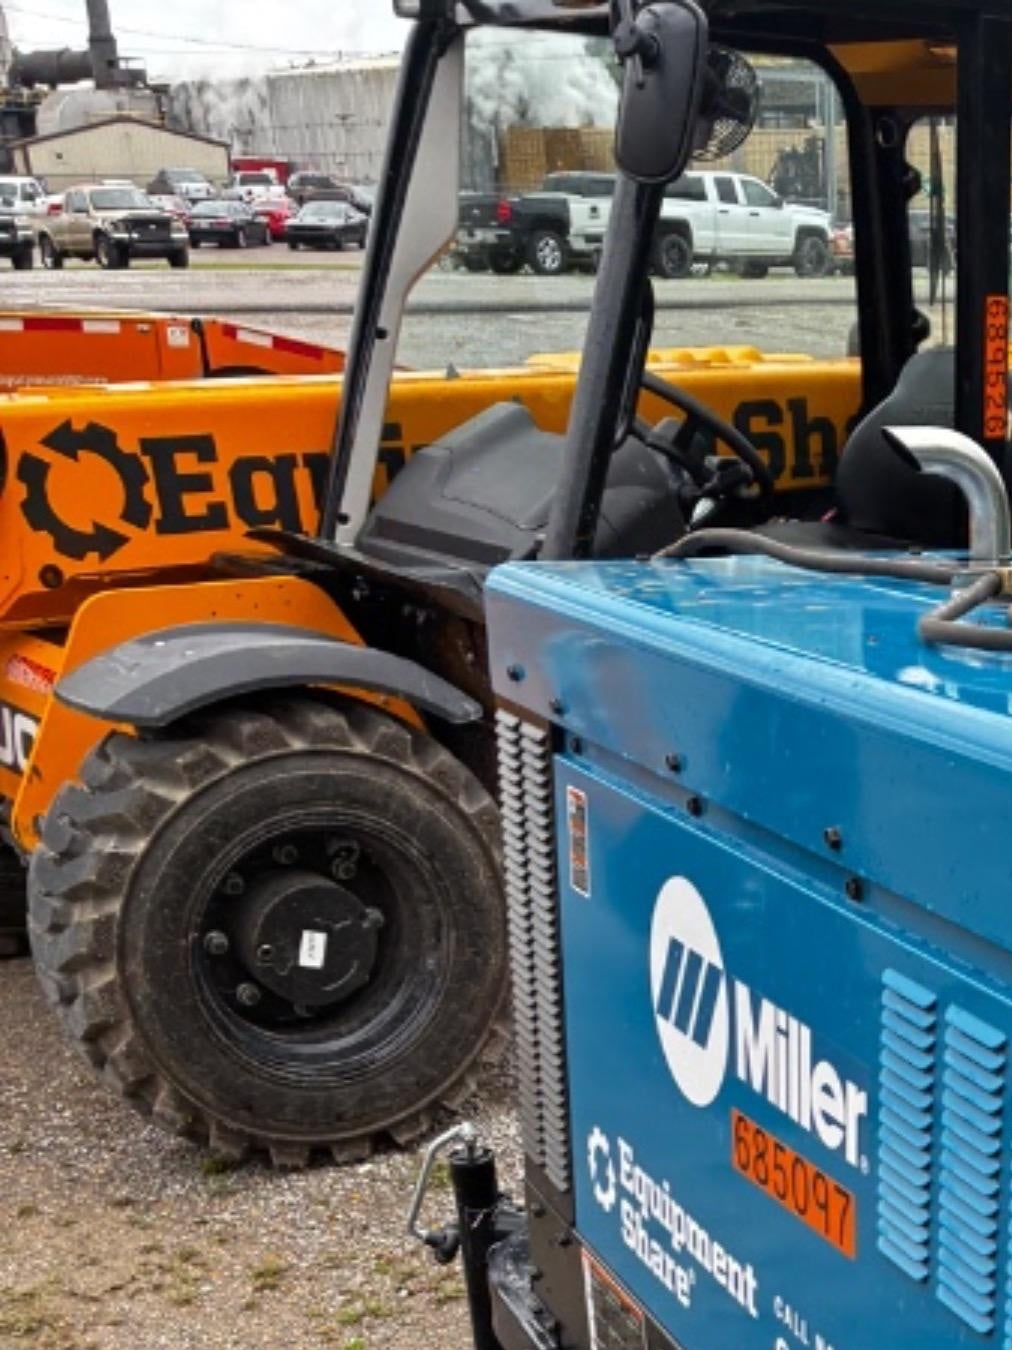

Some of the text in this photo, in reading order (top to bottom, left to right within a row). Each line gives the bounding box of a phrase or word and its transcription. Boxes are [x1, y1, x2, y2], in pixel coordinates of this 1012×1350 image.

[734, 978, 868, 1168] Miller
[617, 1136, 759, 1319] Equipment
[735, 1114, 852, 1248] 685097
[620, 1199, 691, 1309] Share
[773, 1296, 808, 1345] CALL
